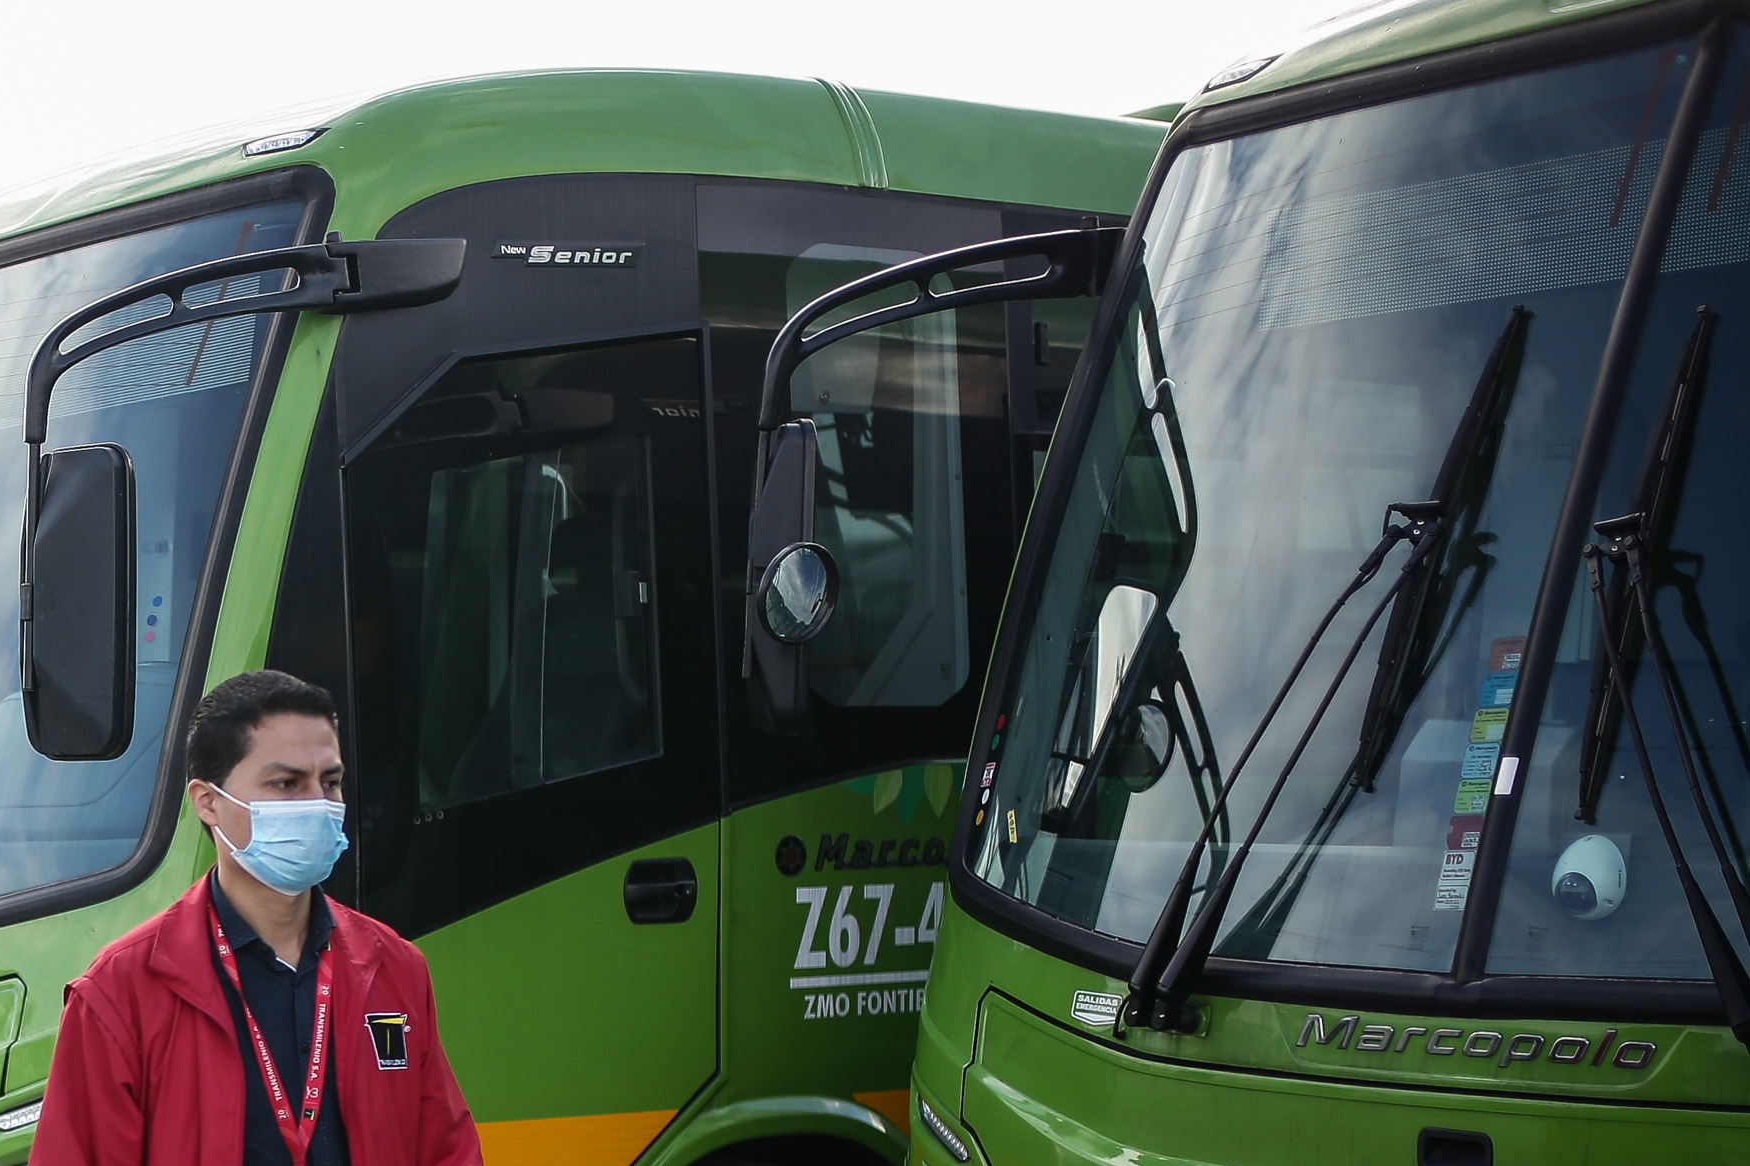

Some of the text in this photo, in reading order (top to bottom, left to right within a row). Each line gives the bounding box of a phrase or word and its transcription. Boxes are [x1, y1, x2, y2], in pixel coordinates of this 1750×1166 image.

[501, 245, 633, 264] New Senior
[815, 833, 946, 871] Marco
[1446, 854, 1464, 865] BYD
[794, 882, 944, 969] Z67-4
[804, 992, 850, 1019] ZMO
[1076, 1002, 1117, 1015] EMERGENCIA
[1077, 994, 1118, 1007] SALIDAS
[312, 1003, 326, 1064] TRANSMILENIO
[1296, 1013, 1657, 1070] Marcopolo
[258, 1041, 283, 1101] TRANSMILENIO
